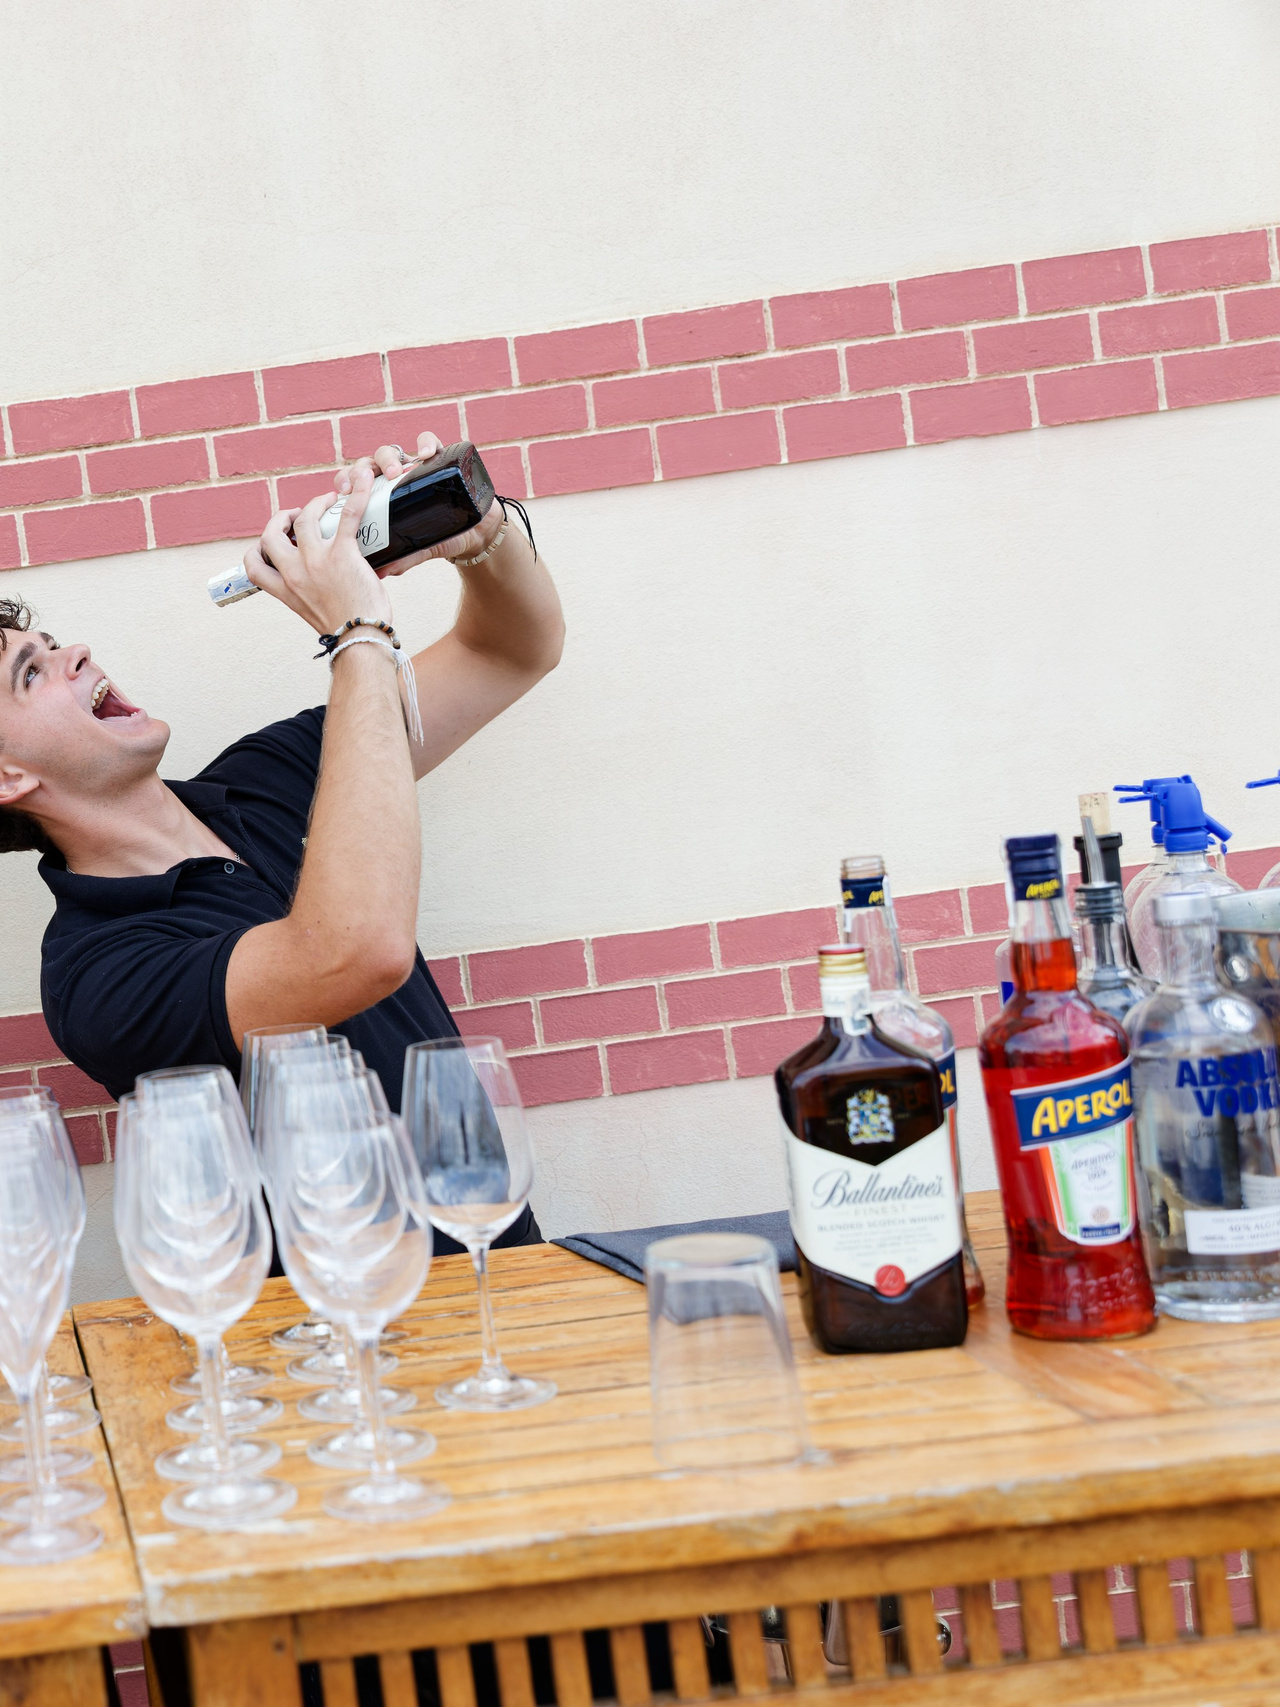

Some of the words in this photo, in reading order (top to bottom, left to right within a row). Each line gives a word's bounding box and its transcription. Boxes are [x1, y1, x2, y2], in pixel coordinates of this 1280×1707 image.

[1031, 1079, 1133, 1137] APEROL
[810, 1168, 944, 1211] Ballantine's
[853, 1203, 907, 1217] FINEST
